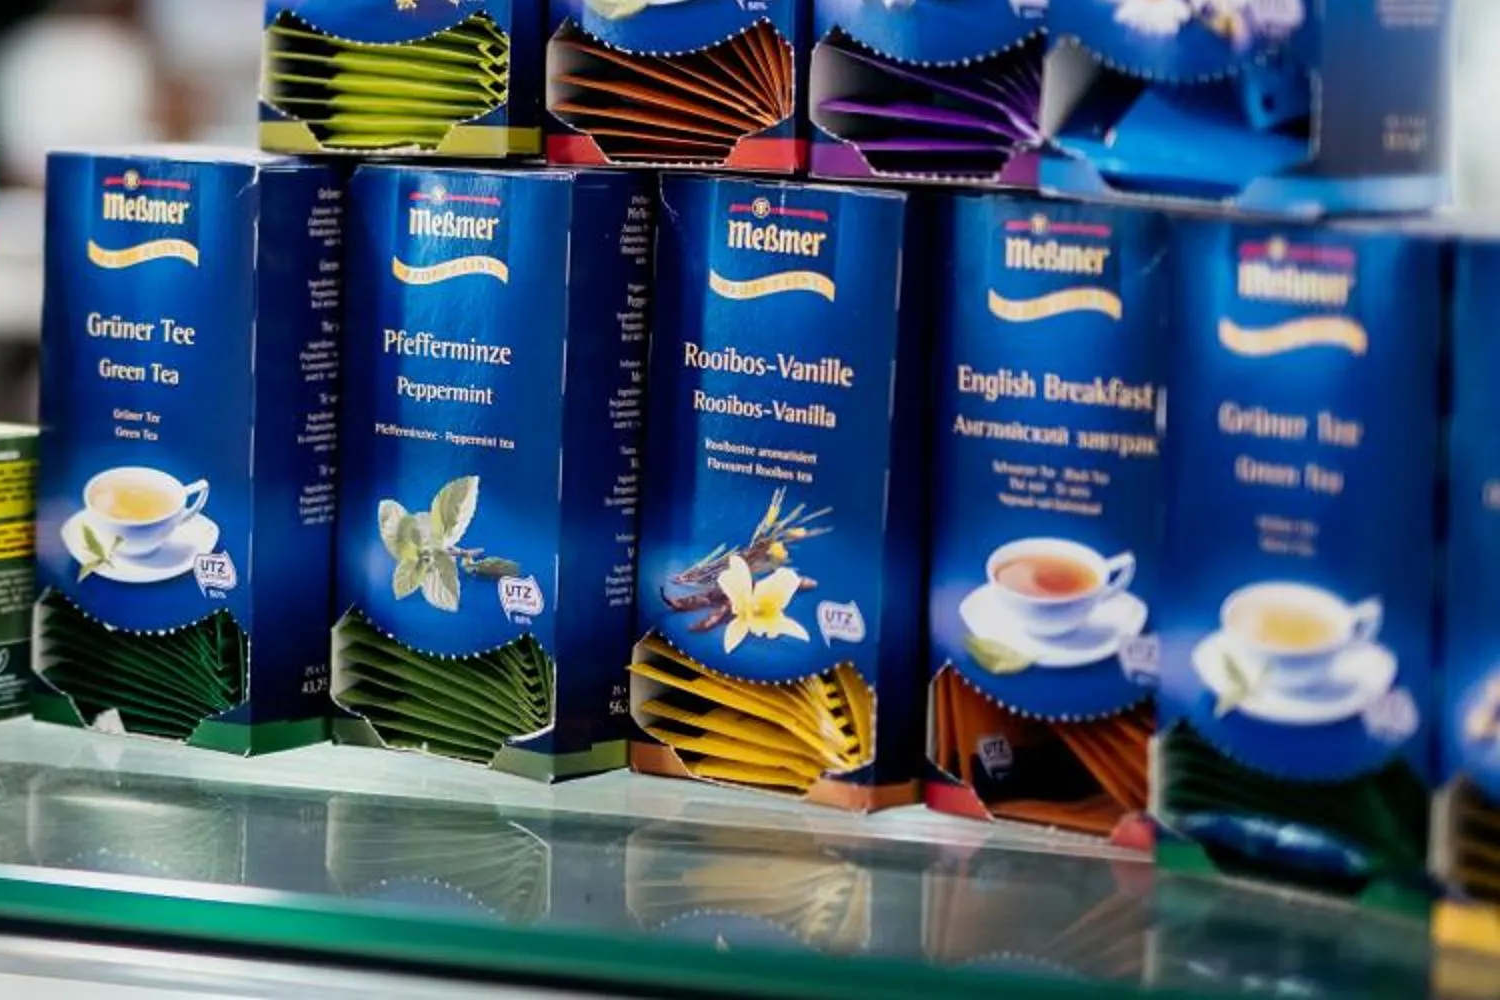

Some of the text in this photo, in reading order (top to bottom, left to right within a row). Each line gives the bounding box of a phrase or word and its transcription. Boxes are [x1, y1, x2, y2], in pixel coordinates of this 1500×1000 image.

[103, 192, 190, 225] Meßmer
[409, 206, 499, 241] Meßmer
[727, 218, 827, 257] Meßmer
[86, 311, 196, 345] Grüner Tee
[384, 328, 512, 366] Pfefferminze
[99, 357, 180, 385] Green Tea
[684, 341, 854, 387] Rooibos-Vanille
[396, 376, 494, 406] Peppermint
[957, 363, 1154, 411] English Breakfast
[112, 408, 144, 423] Grüner
[693, 389, 837, 429] Rooibos-Vanilla
[115, 426, 159, 442] Green Tea
[201, 559, 226, 574] UTZ
[505, 584, 532, 599] UTZ
[825, 608, 854, 625] UTZ
